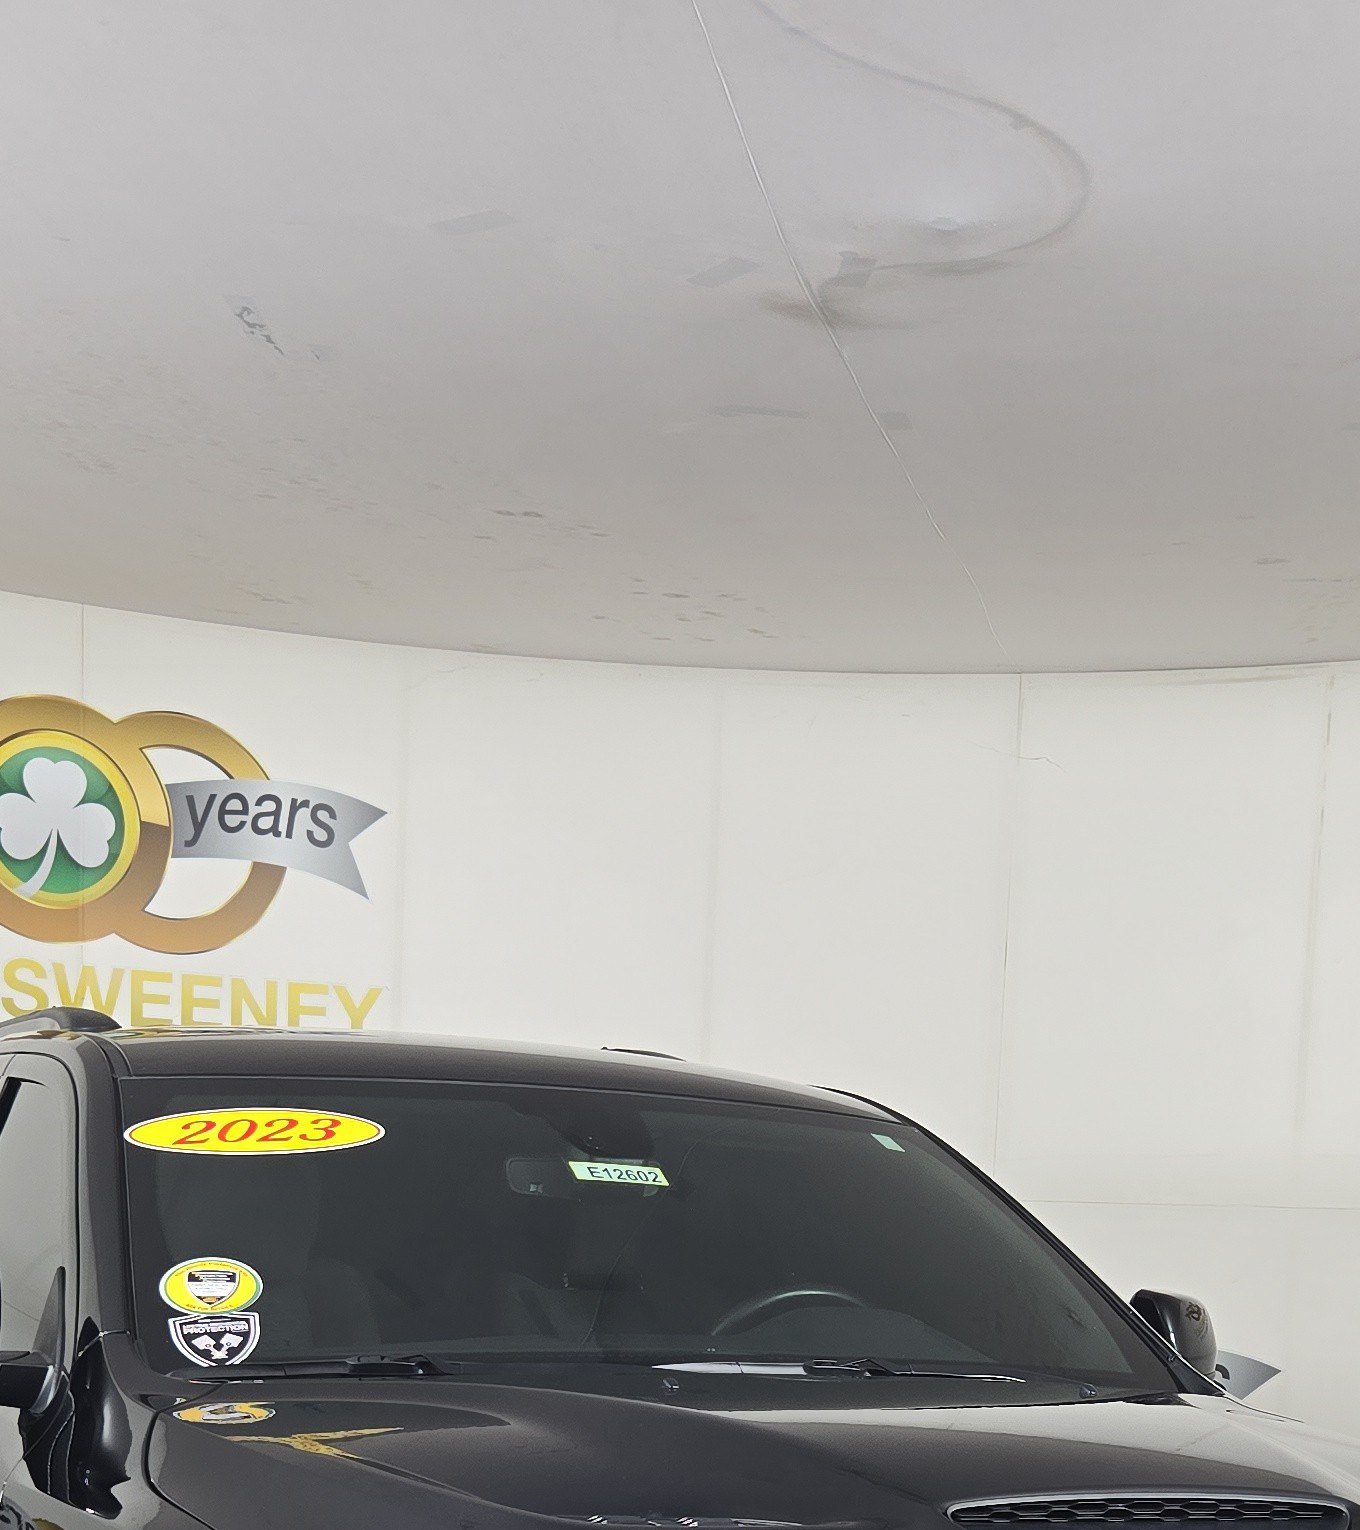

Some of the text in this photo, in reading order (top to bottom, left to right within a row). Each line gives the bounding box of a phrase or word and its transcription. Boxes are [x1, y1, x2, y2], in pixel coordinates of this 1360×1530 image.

[184, 790, 337, 849] years
[0, 958, 384, 1030] SWEENEY
[172, 1118, 342, 1145] 2023
[586, 1166, 662, 1183] E12602
